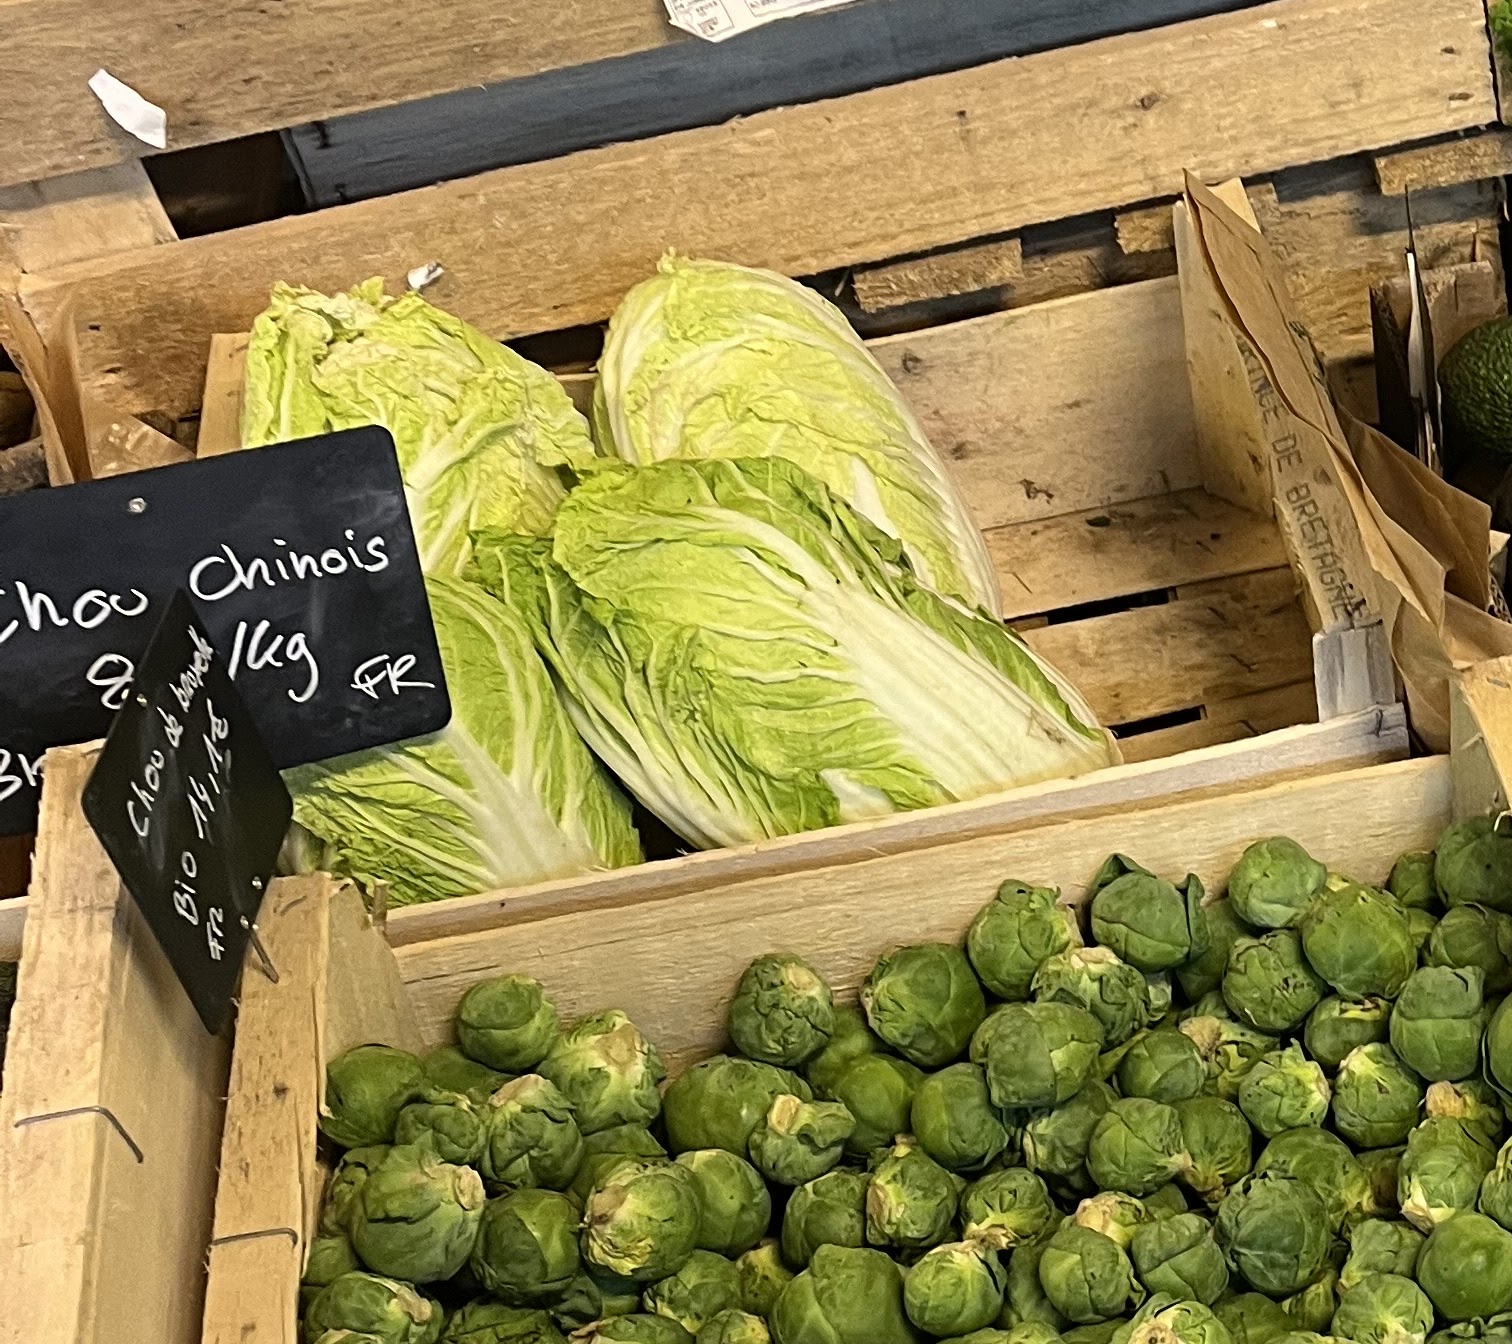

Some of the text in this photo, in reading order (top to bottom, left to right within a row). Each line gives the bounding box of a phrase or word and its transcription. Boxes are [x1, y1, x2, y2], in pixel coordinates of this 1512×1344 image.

[1271, 432, 1303, 473] DE
[190, 529, 389, 600] Chinois
[1286, 482, 1364, 620] BRETAGNE
[351, 654, 436, 699] FR
[127, 749, 165, 837] Chou
